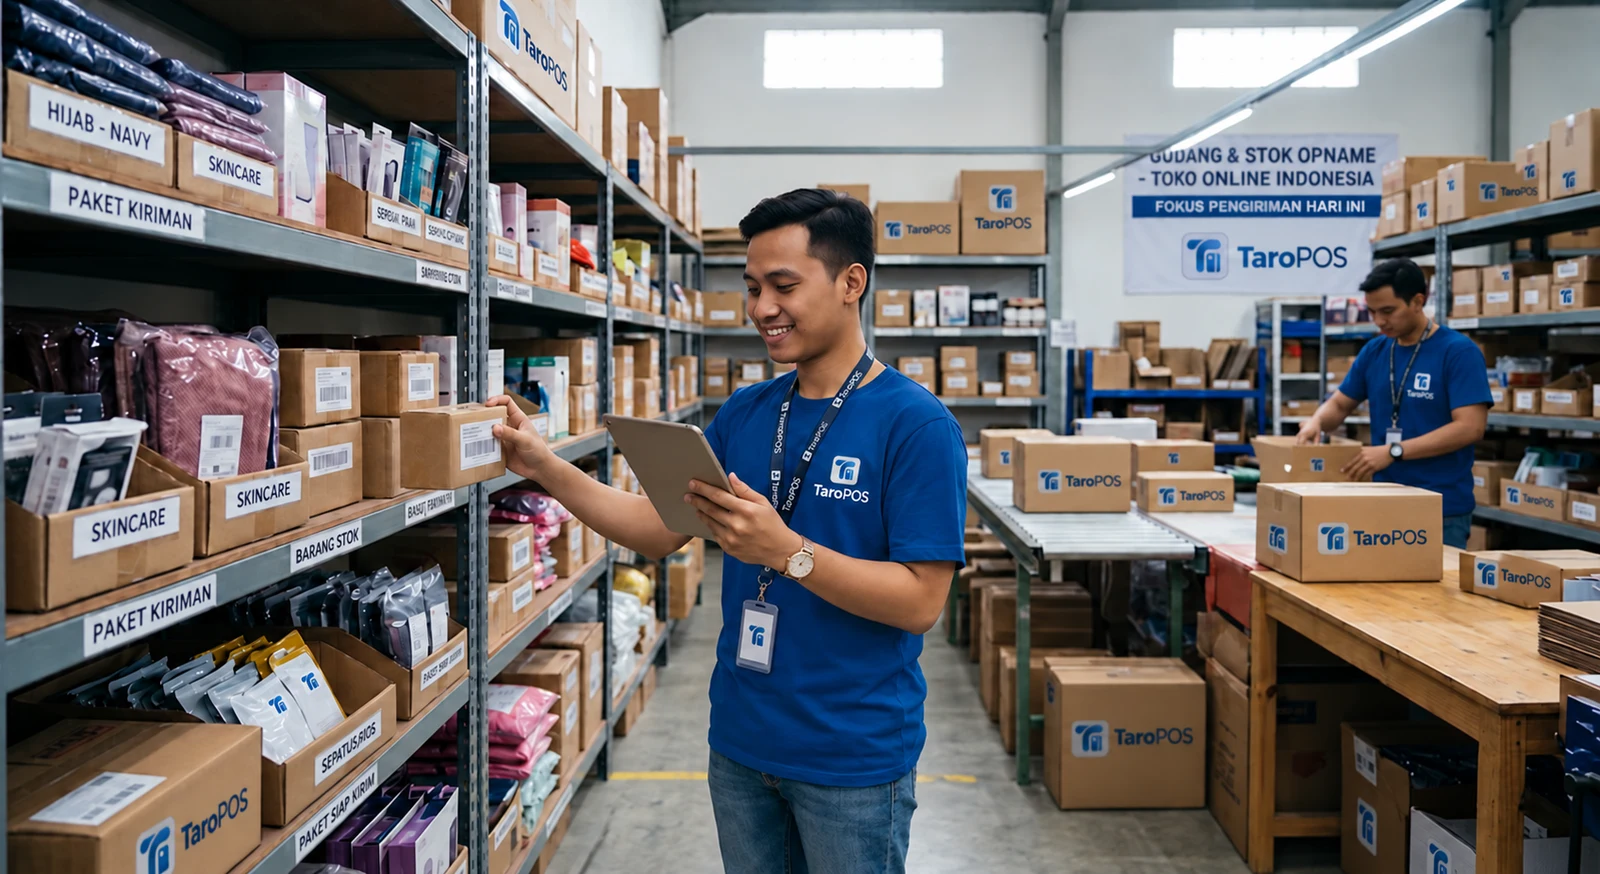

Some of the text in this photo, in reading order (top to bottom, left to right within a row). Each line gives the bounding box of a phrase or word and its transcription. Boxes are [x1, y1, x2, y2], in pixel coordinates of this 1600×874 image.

[523, 28, 568, 92] TaroPOS
[48, 101, 94, 132] HIJAB
[110, 122, 151, 150] NAVY
[1150, 146, 1376, 164] GUDANG & STOK OPNAME
[208, 155, 261, 186] SKINCARE
[1151, 170, 1197, 187] TOKO
[1202, 170, 1271, 187] ONLINE
[1276, 170, 1374, 186] INDONESIA
[1501, 185, 1538, 197] TaroPOS
[68, 186, 192, 230] PAKET KIRIMAN
[1155, 200, 1365, 213] FOKUS PENGIRIMAN HARI INI
[906, 223, 951, 235] TaroPOS
[975, 217, 1032, 230] TaroPOS
[1237, 246, 1348, 268] TaroPOS
[1065, 475, 1122, 488] TaroPOS
[237, 481, 291, 508] SKINCARE
[813, 484, 869, 503] TaroPOS
[1180, 490, 1225, 502] TaroPOS
[1522, 493, 1555, 509] TaroPOS
[91, 507, 166, 543] SKINCARE
[296, 528, 360, 564] BARANG STOK
[1353, 529, 1427, 546] TaroPOS
[1501, 568, 1551, 590] TaroPOS
[93, 584, 212, 644] PAKET KIRIMAN
[1114, 727, 1193, 745] TaroPOS
[181, 787, 248, 850] TaroPOS
[299, 772, 375, 852] PAKET SIAP KIRIM
